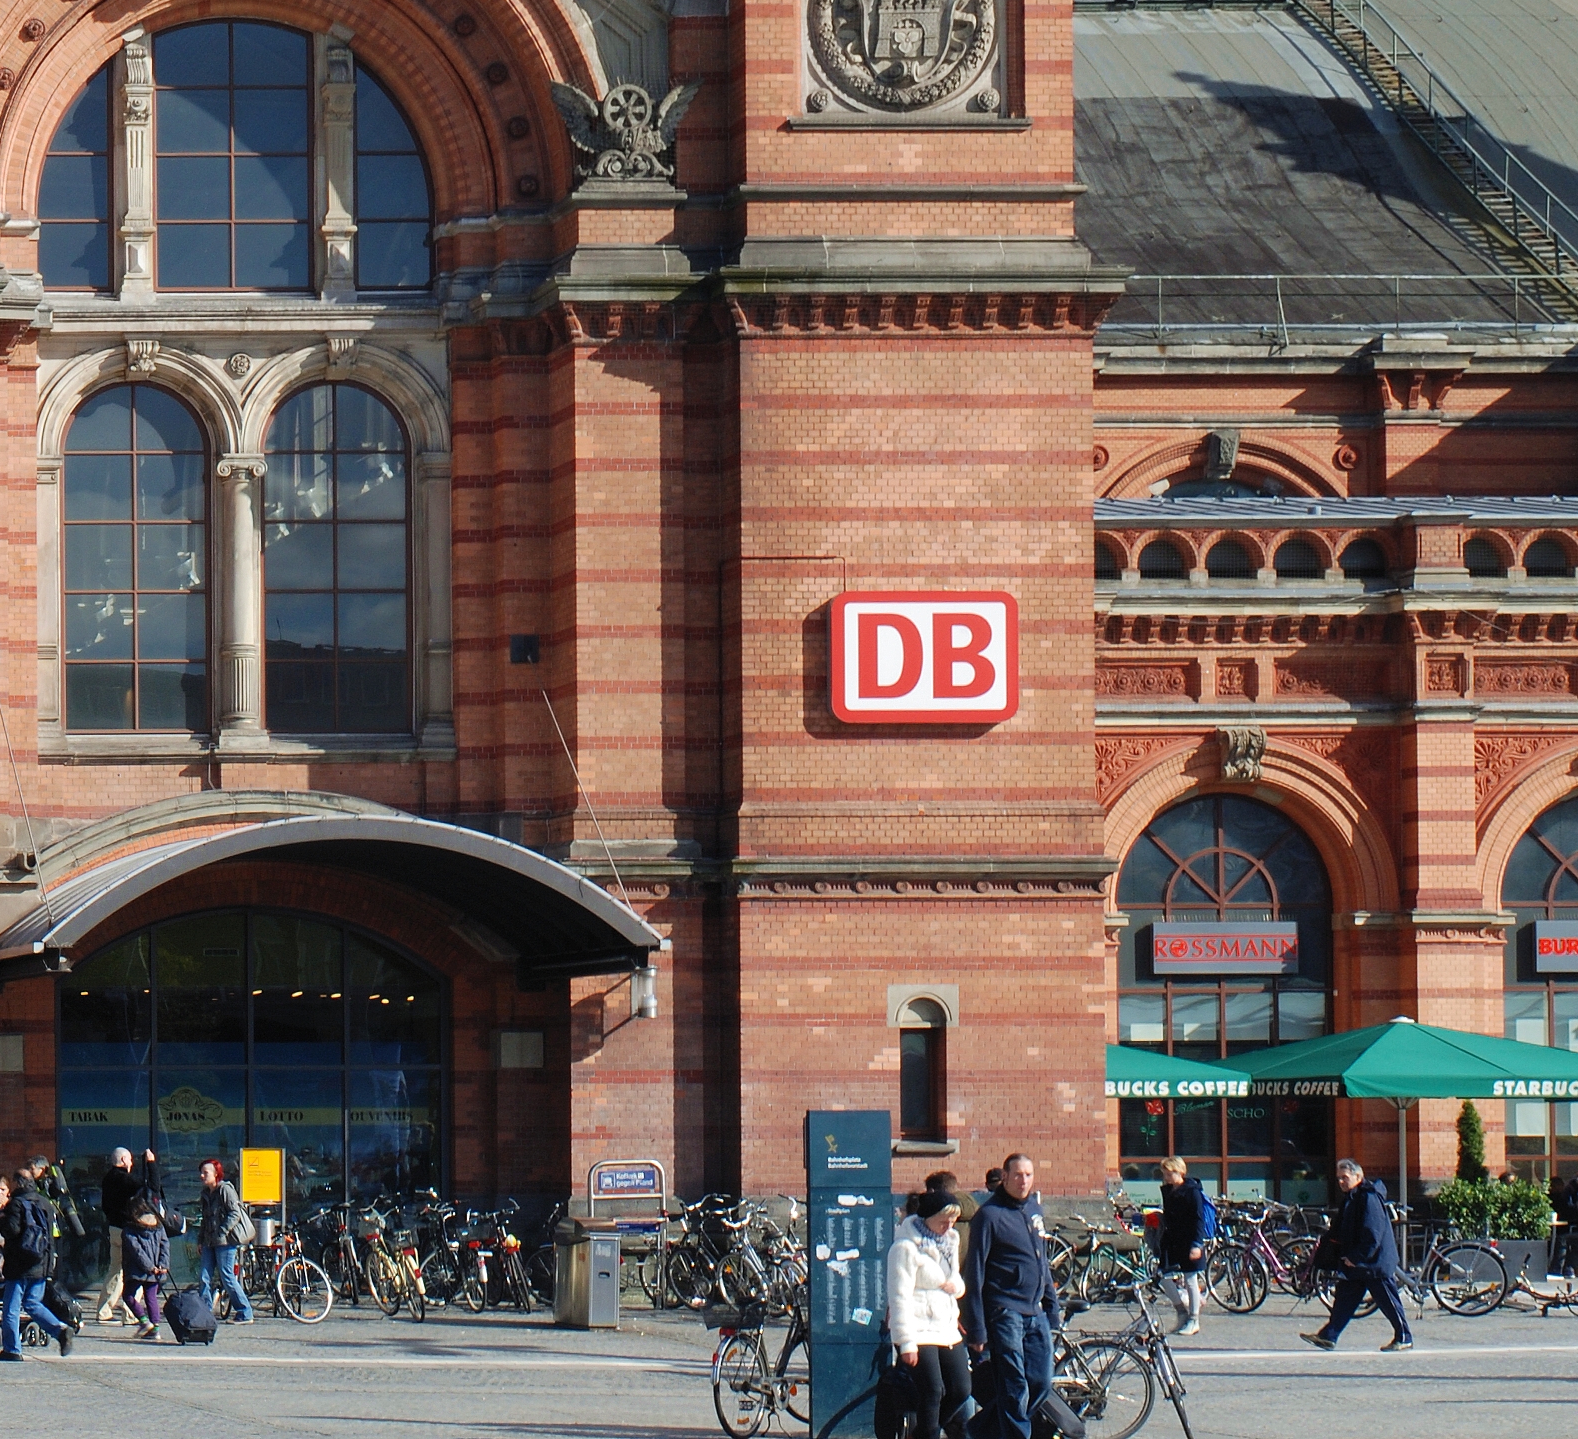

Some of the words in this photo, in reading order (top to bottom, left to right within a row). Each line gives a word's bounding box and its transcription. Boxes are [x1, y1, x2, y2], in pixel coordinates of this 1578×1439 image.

[856, 612, 996, 699] DB
[1154, 939, 1298, 958] ROSSMANN
[1176, 1080, 1249, 1097] COFFEE
[1292, 1081, 1339, 1096] COFFEE
[69, 1111, 108, 1122] TABAK
[166, 1111, 206, 1122] JONAS
[260, 1110, 304, 1122] LOTTO
[346, 1110, 413, 1122] OUVENIRS
